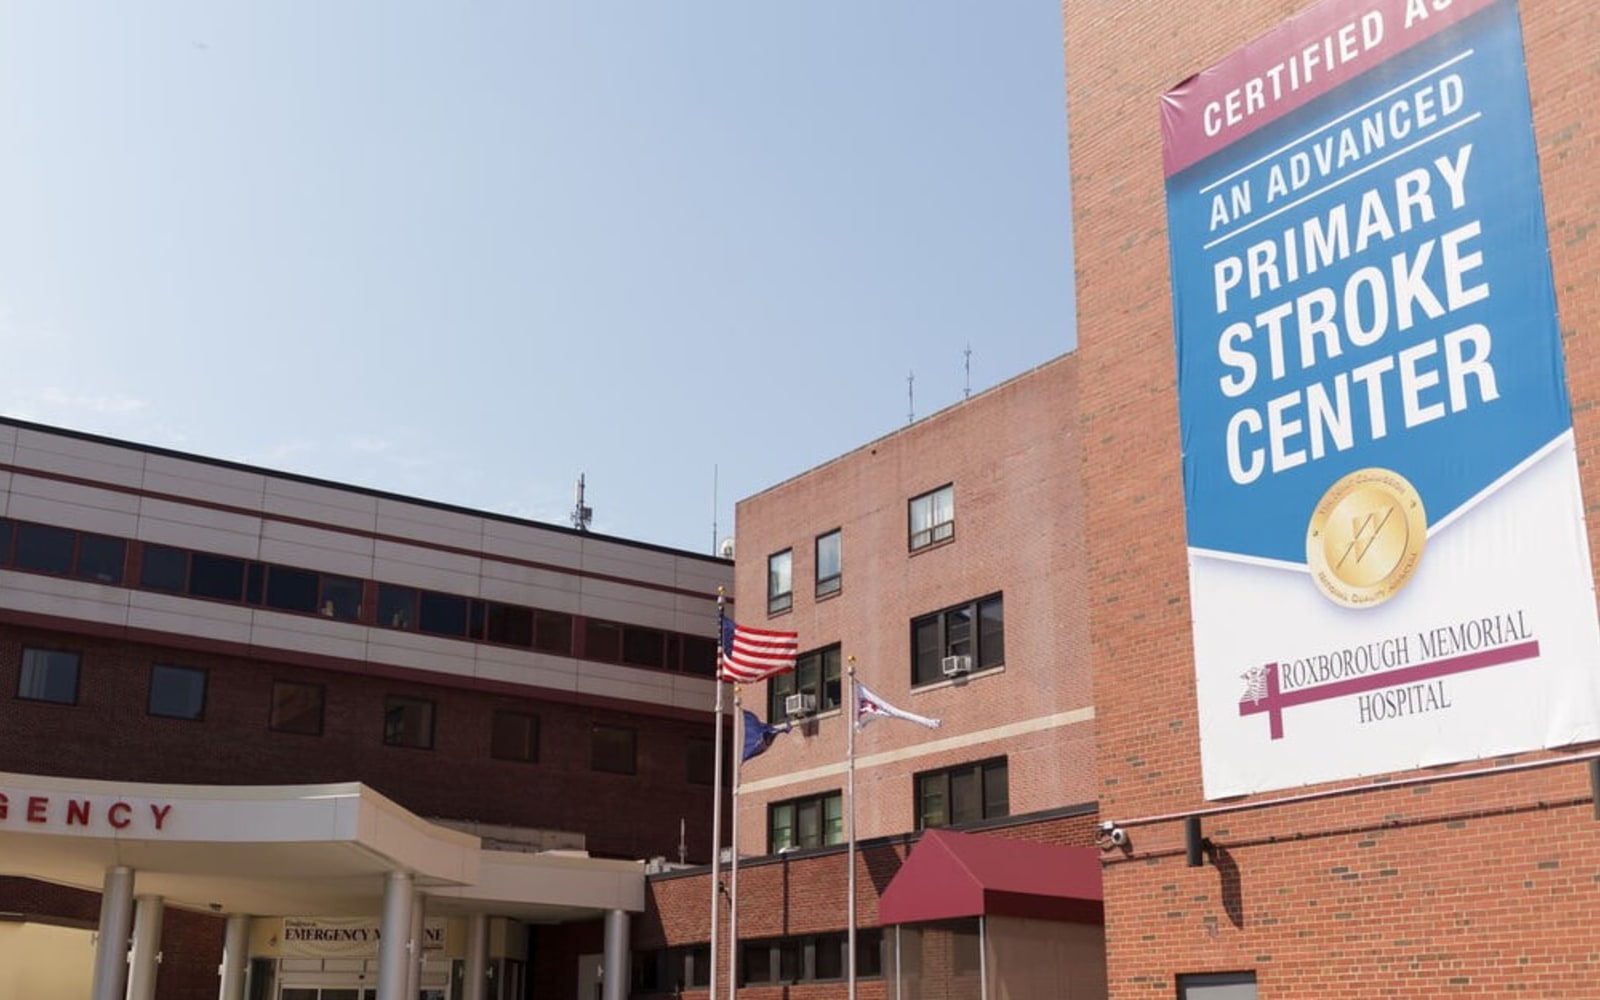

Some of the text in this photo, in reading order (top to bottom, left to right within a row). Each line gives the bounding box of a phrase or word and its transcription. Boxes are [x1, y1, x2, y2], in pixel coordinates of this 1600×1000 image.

[1203, 10, 1384, 138] CERTIFIED
[1209, 73, 1465, 231] AN ADVANCED
[1213, 143, 1473, 314] PRIMARY
[1218, 220, 1490, 398] STROKE
[1225, 323, 1500, 485] CENTER
[1282, 610, 1532, 690] ROXBOROUGH MEMORIAL
[1358, 680, 1451, 723] HOSPITAL
[284, 928, 369, 941] EMERGENCY
